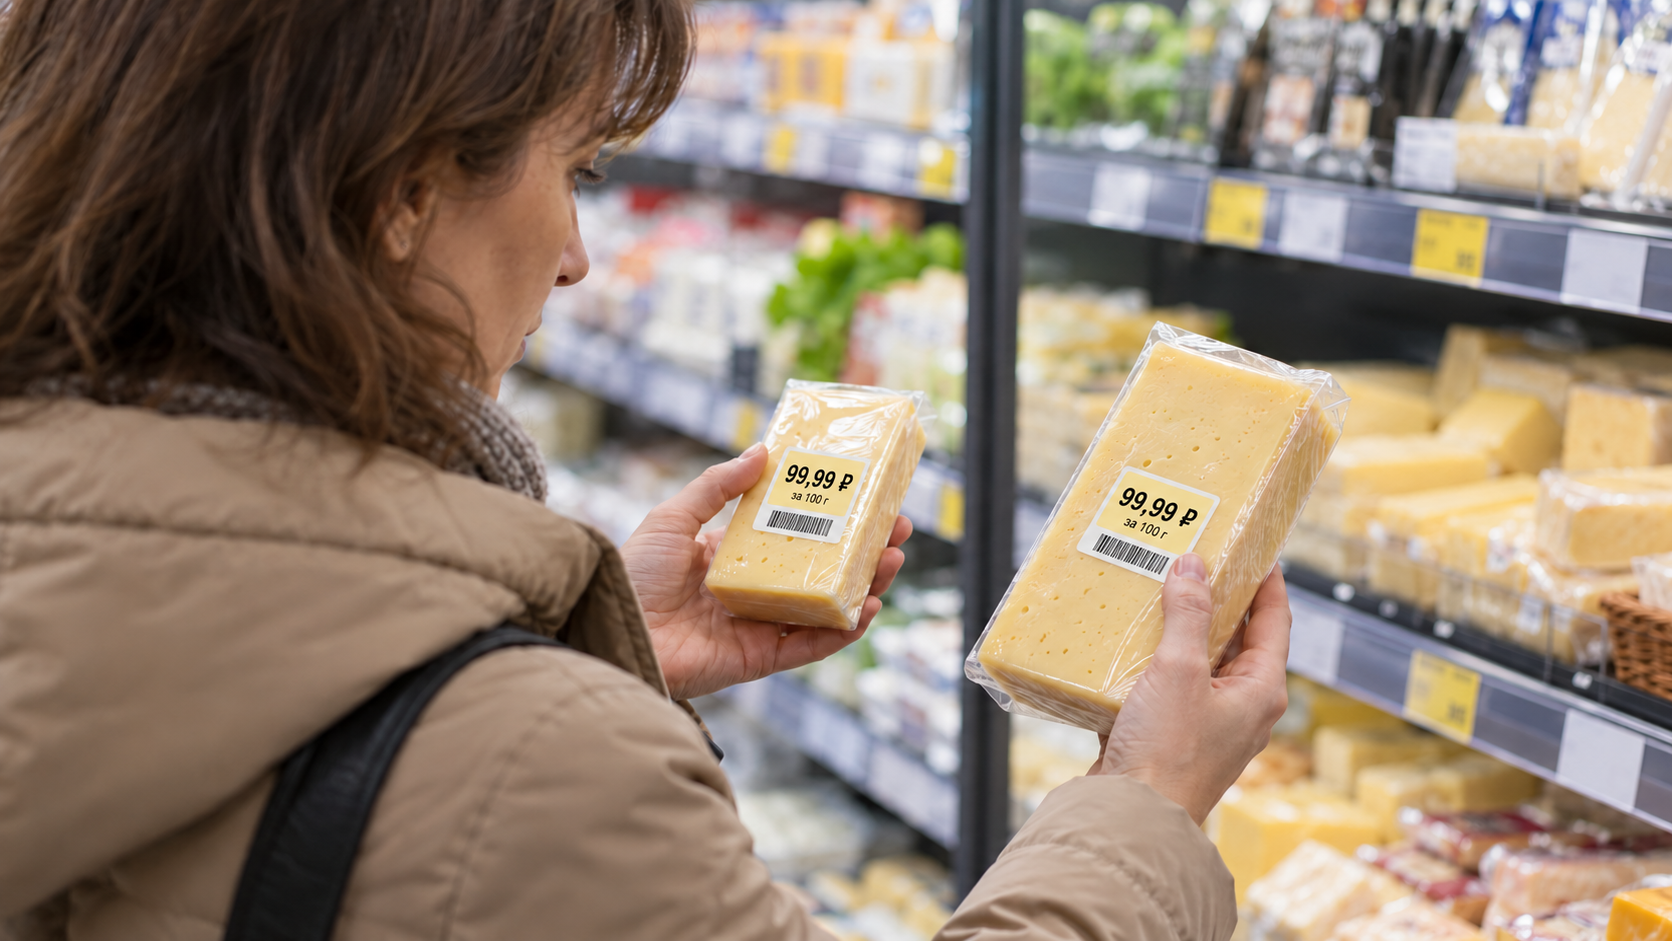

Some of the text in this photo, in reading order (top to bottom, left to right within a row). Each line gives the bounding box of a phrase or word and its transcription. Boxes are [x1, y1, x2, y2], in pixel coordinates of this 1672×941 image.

[785, 464, 854, 492] 99,99 ₽
[791, 492, 830, 505] за 100 г
[1118, 487, 1199, 527] 99,99 ₽
[1123, 518, 1168, 539] за 100 г
